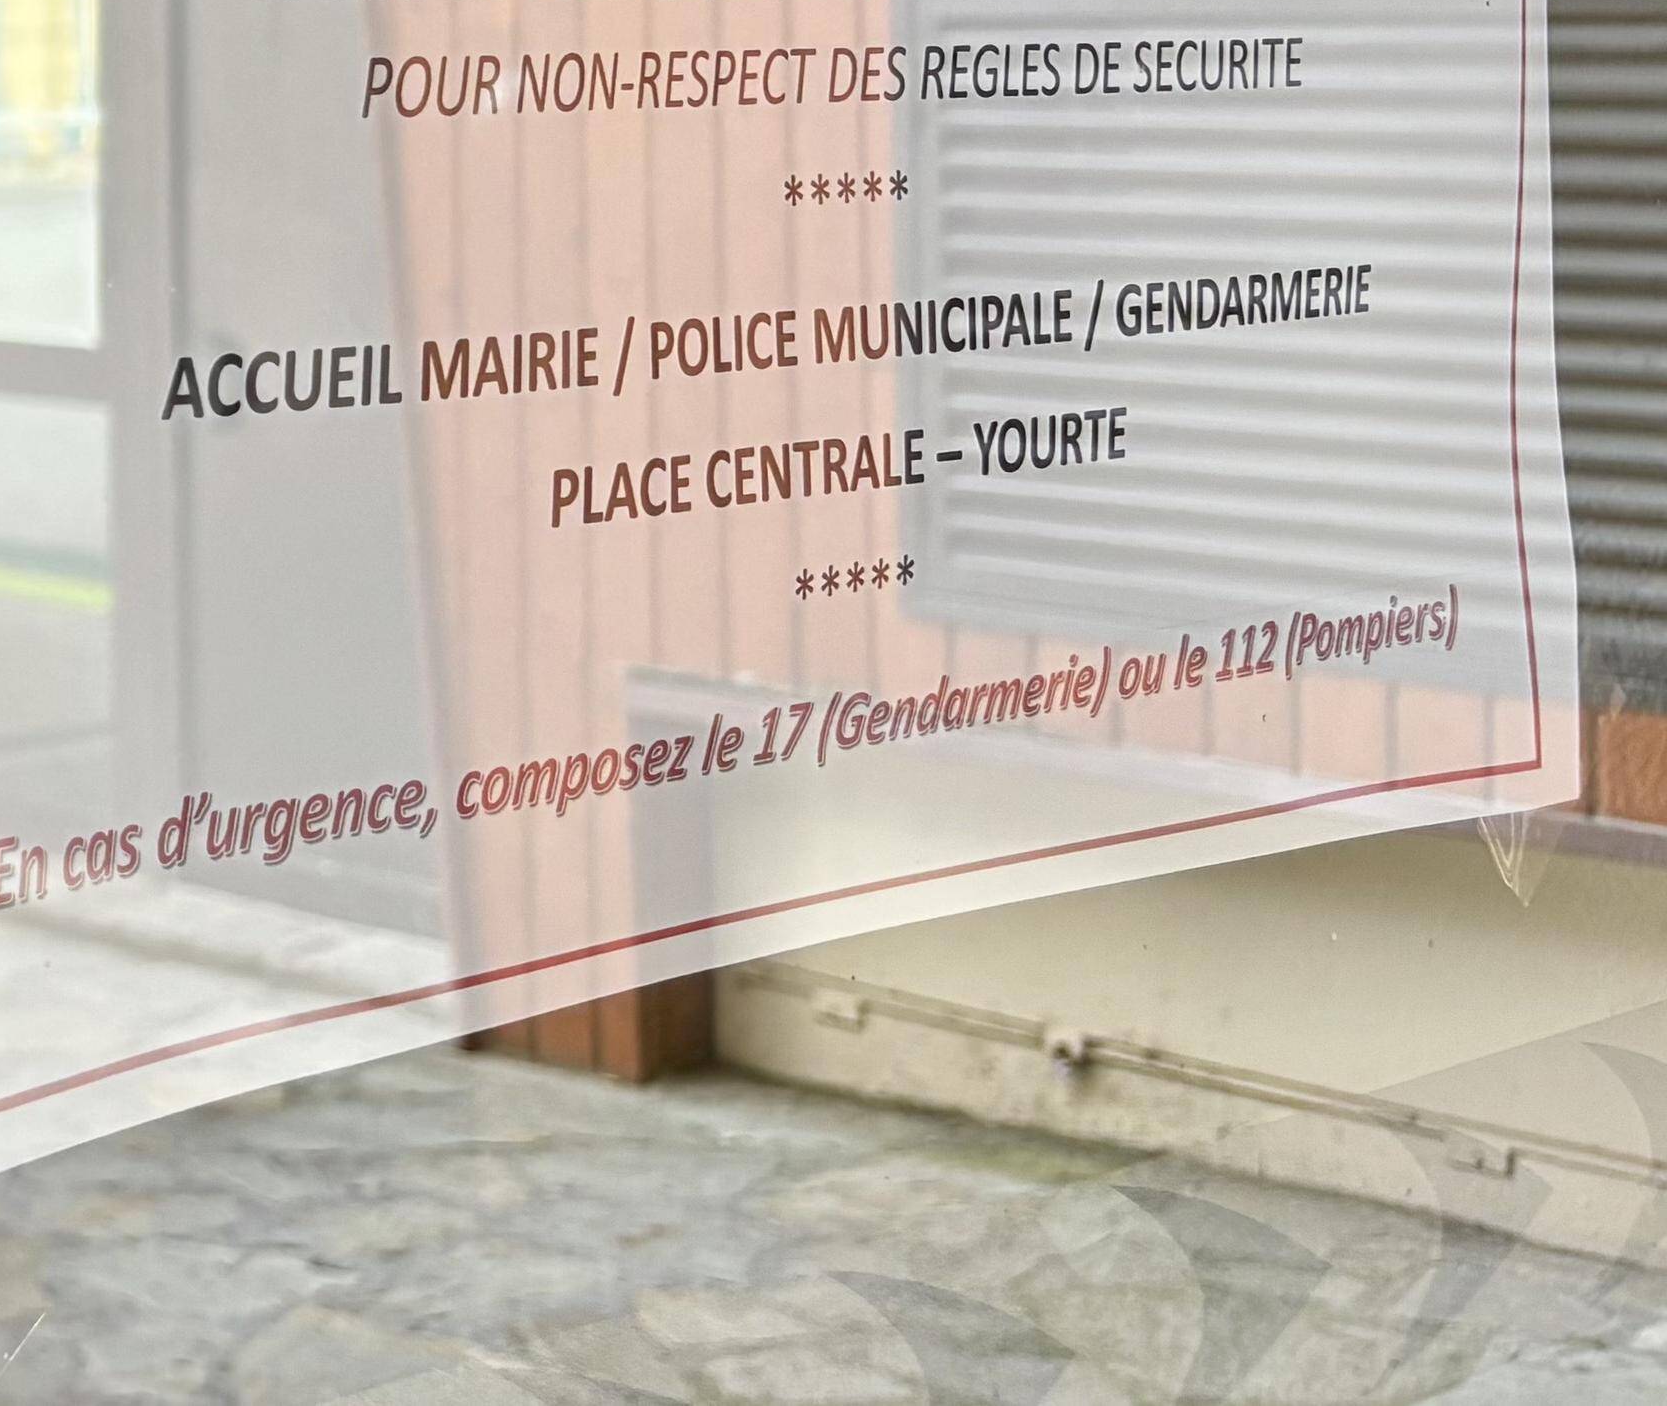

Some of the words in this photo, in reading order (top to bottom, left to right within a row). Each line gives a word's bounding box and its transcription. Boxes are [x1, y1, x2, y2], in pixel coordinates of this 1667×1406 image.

[362, 54, 500, 118] POUR
[517, 48, 817, 113] NON-RESPECT
[828, 45, 906, 105] DES
[921, 42, 1061, 100] REGLES
[1074, 41, 1121, 94] DE
[1133, 37, 1303, 93] SECURITE
[161, 344, 402, 420] ACCUEIL
[420, 327, 598, 401] MAIRIE
[612, 316, 634, 396] /
[650, 310, 798, 380] POLICE
[813, 289, 1072, 363] MUNICIPALE
[1084, 279, 1103, 351] /
[1115, 263, 1372, 337] GENDARMERIE
[551, 454, 691, 528] PLACE
[706, 429, 925, 508] CENTRALE
[973, 407, 1128, 476] YOURTE
[63, 821, 142, 890] cas
[157, 777, 439, 866] d’urgence,
[456, 733, 693, 820] composez
[703, 712, 744, 771] le
[753, 700, 813, 765] 17
[817, 645, 1112, 767] (Gendarmerie)
[1118, 653, 1166, 700] ou
[1173, 633, 1205, 689] le
[1216, 620, 1276, 683] 112
[1284, 584, 1459, 678] (Pompiers)
